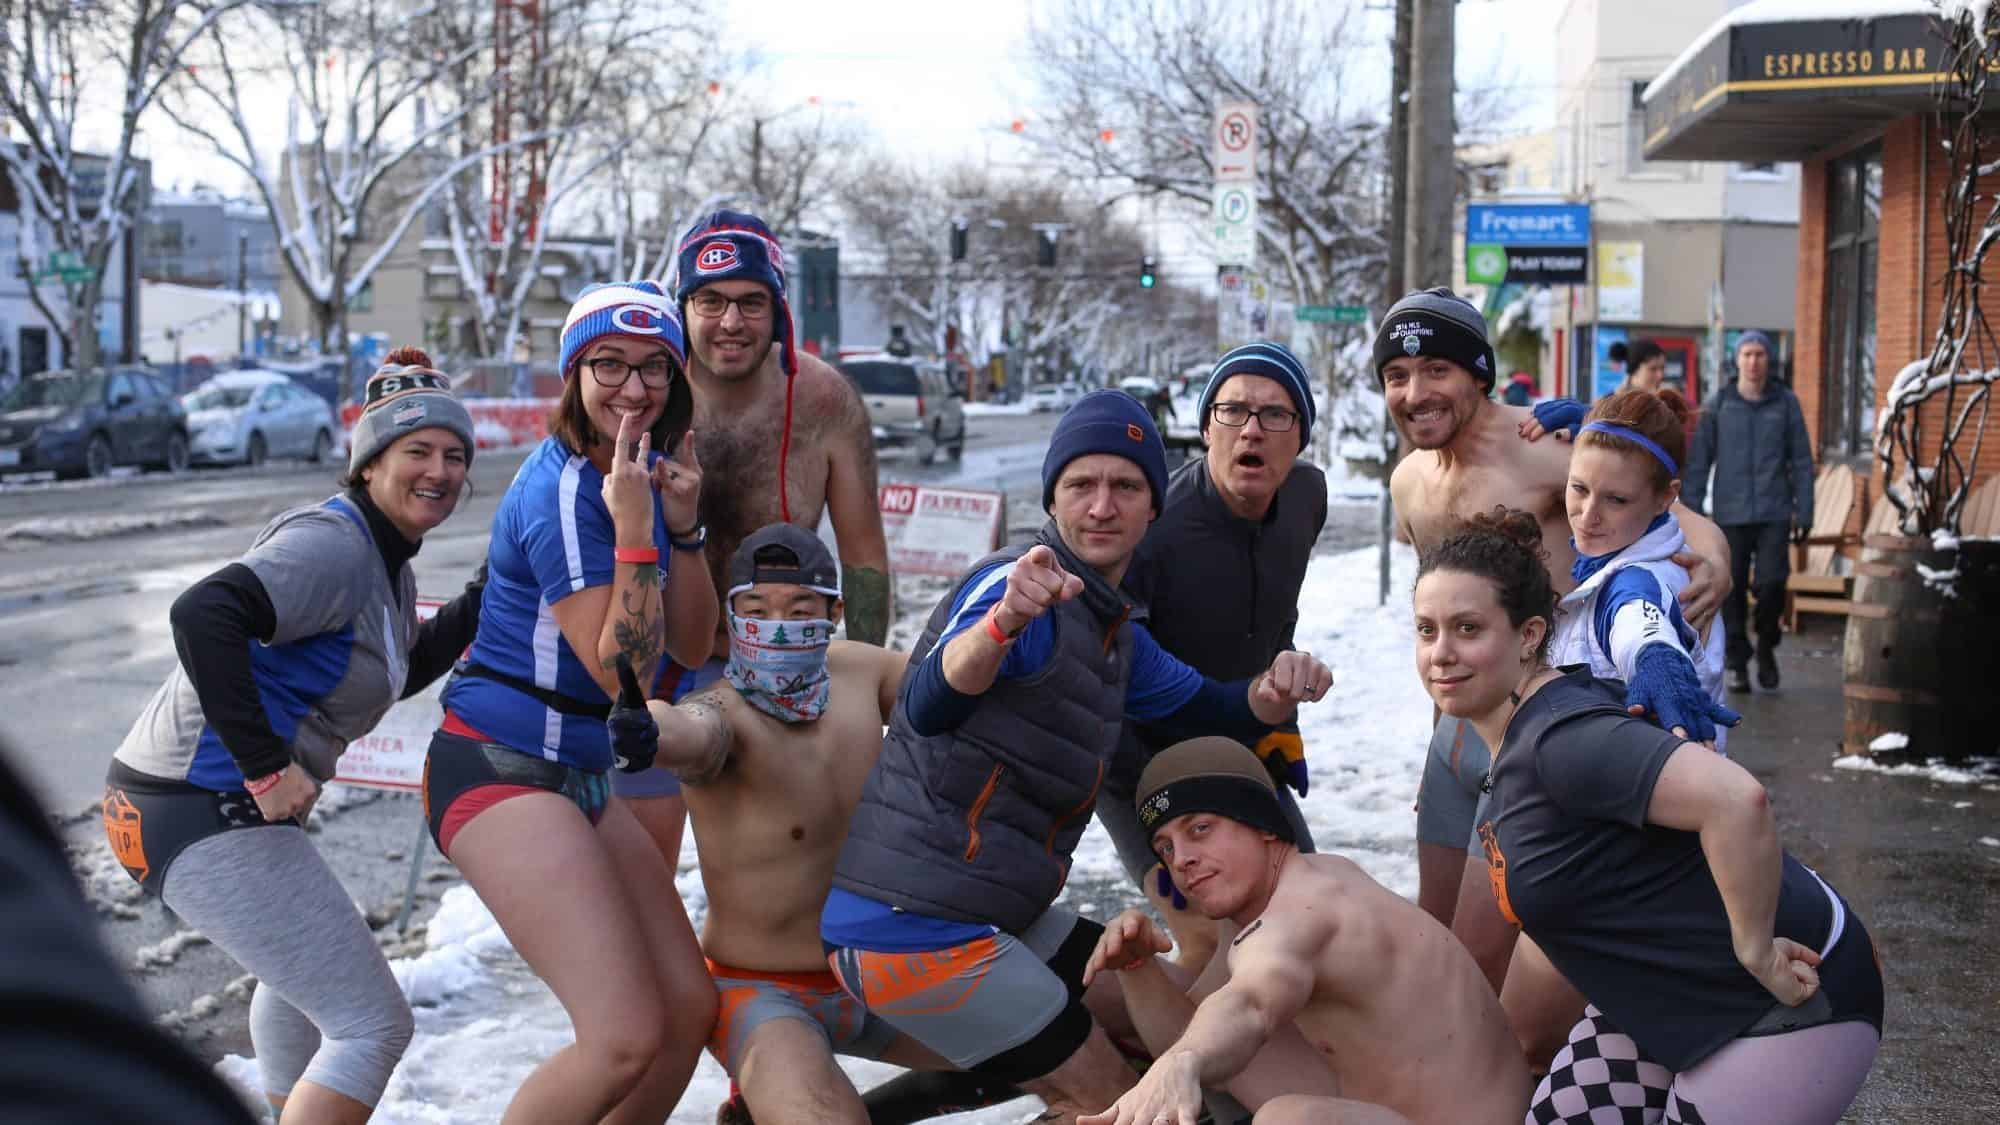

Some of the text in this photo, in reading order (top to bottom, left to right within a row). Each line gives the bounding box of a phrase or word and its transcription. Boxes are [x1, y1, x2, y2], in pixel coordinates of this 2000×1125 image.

[1763, 48, 1927, 77] ESPRESSO BAR
[882, 488, 914, 511] NO
